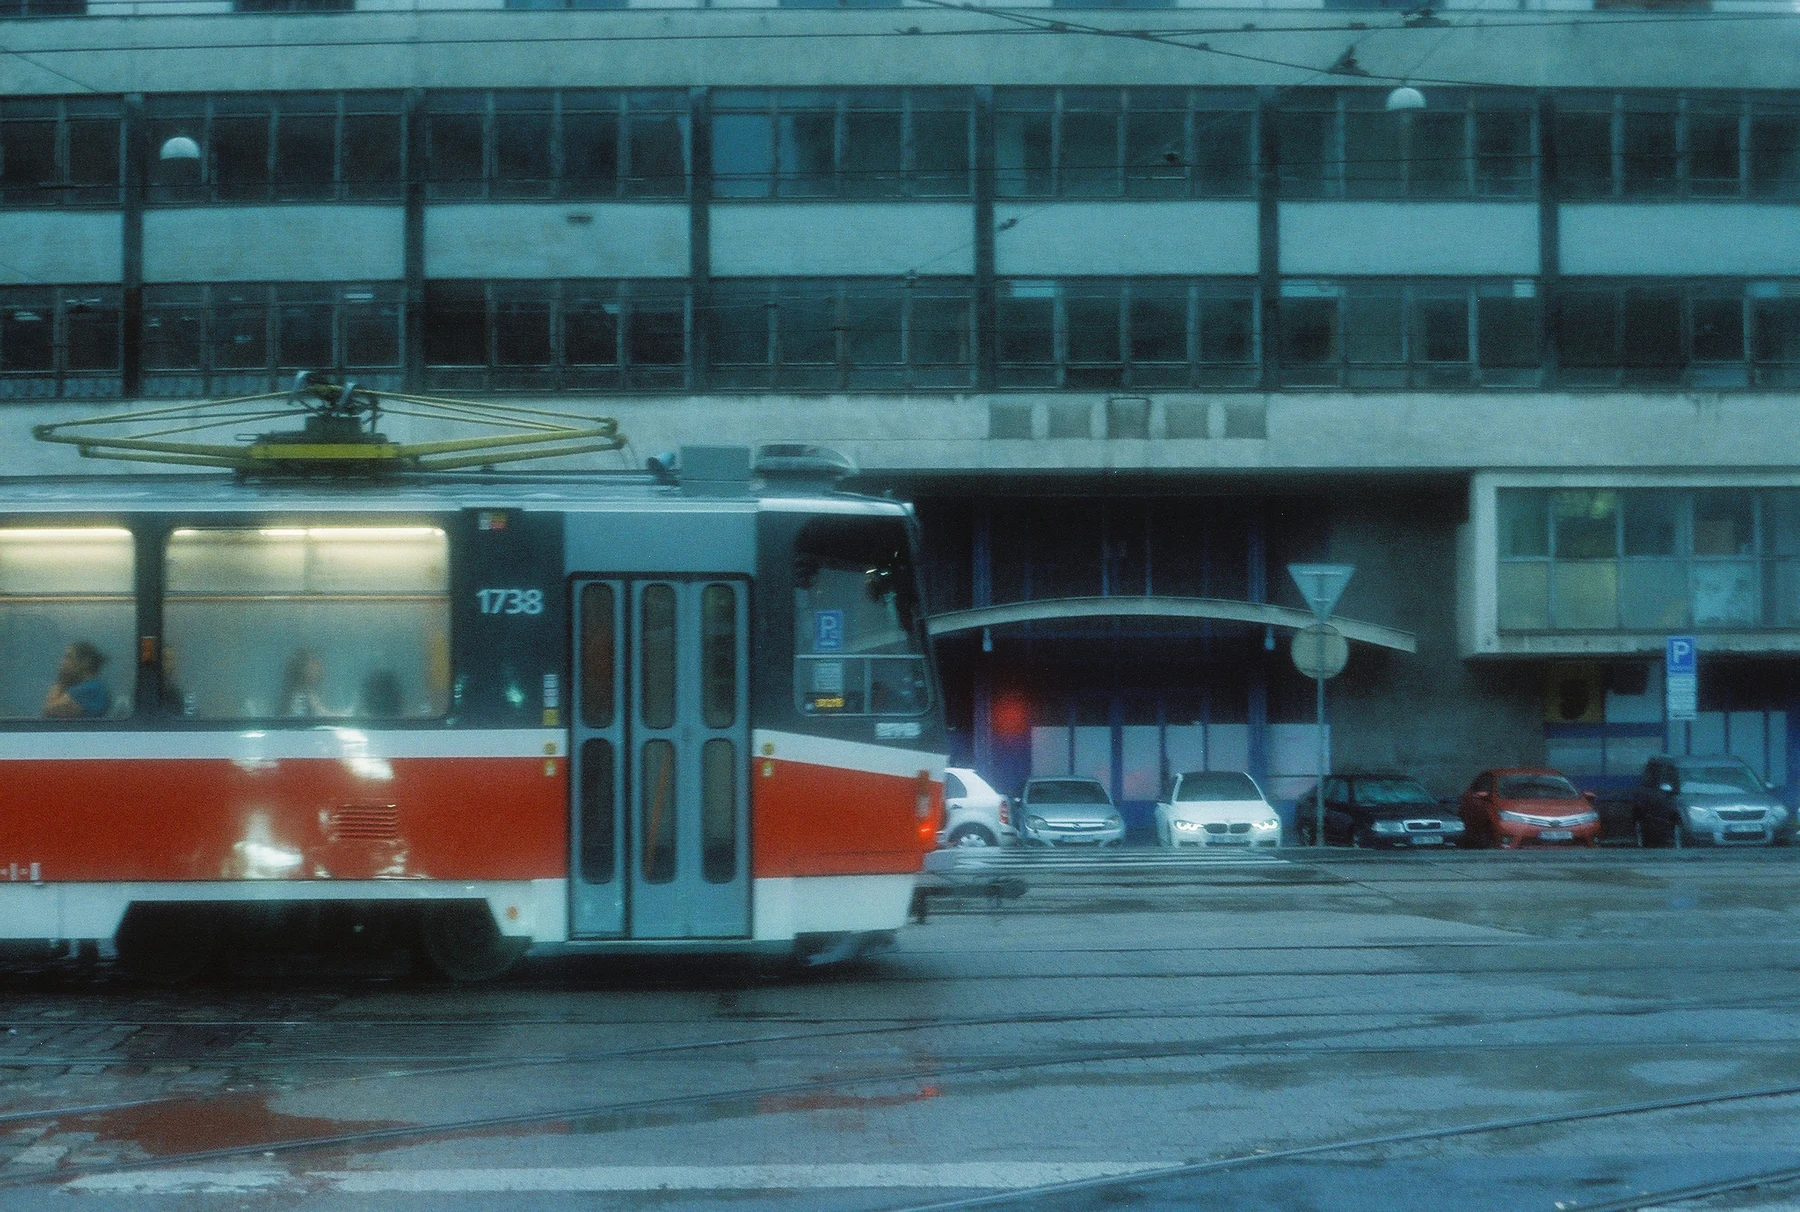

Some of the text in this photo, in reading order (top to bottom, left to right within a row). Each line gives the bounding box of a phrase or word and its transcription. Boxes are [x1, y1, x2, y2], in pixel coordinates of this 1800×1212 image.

[476, 588, 543, 614] 1738
[820, 615, 837, 638] P
[1673, 641, 1690, 663] P
